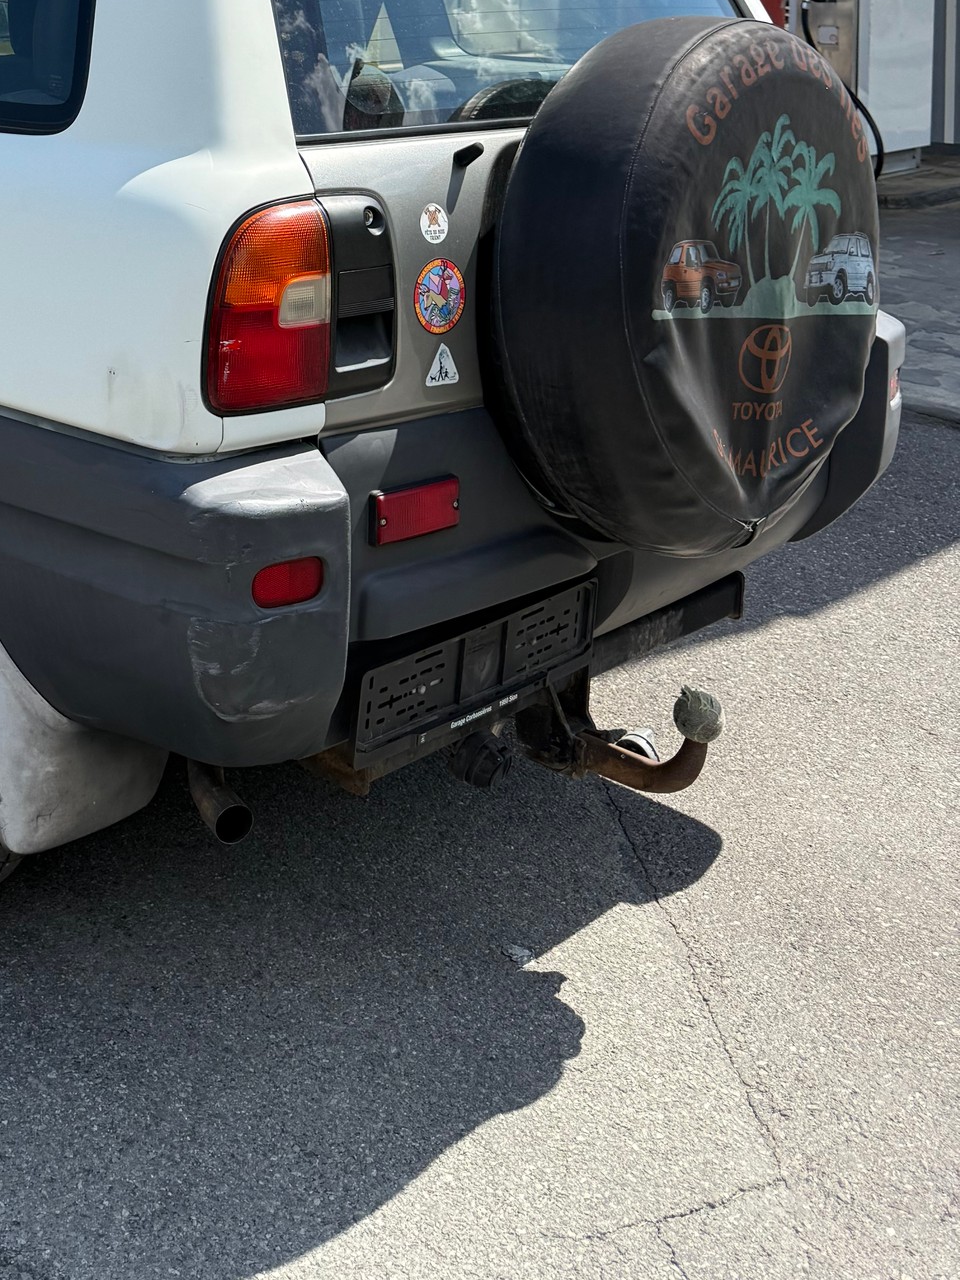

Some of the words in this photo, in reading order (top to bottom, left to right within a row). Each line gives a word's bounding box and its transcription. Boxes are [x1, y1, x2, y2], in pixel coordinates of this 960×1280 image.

[686, 38, 785, 146] Garage
[732, 400, 783, 420] TOYOTA
[450, 716, 466, 729] Garage
